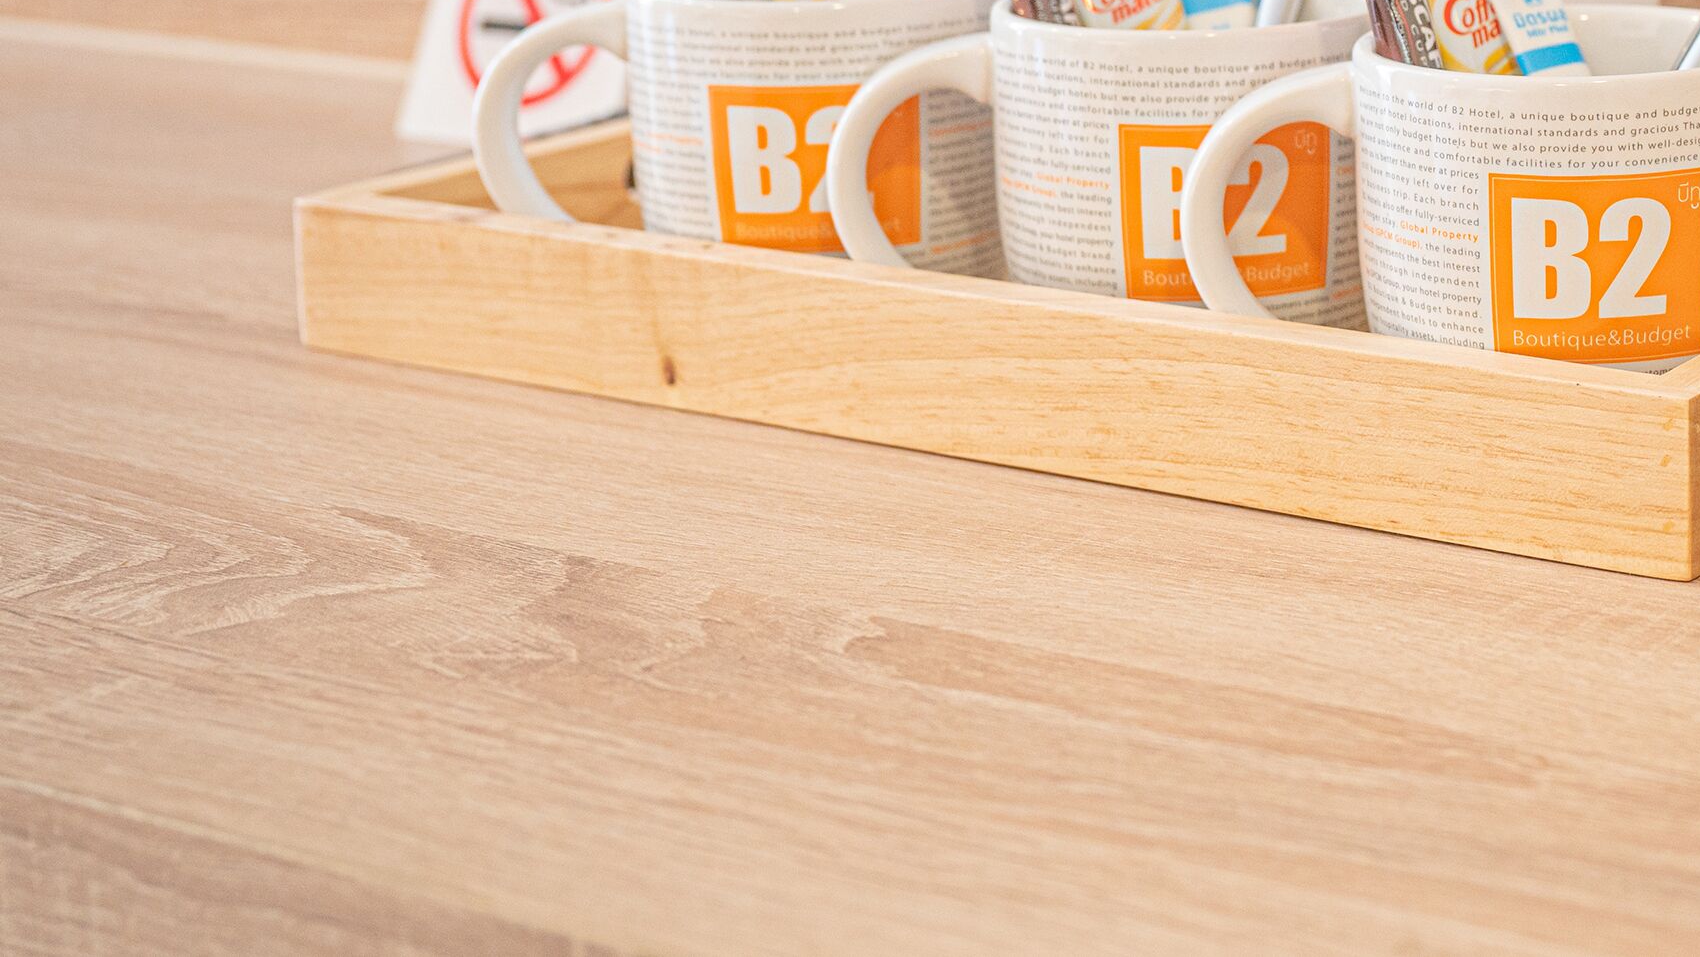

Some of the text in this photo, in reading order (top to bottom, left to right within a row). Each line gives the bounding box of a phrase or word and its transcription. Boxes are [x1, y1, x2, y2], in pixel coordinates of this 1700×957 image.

[1472, 18, 1502, 48] ma
[1148, 66, 1188, 74] unique
[1194, 64, 1249, 74] boutique
[1254, 62, 1275, 70] and
[1090, 78, 1160, 88] international
[1164, 80, 1220, 88] standards
[1392, 94, 1404, 105] the
[1408, 99, 1434, 111] world
[1438, 102, 1448, 112] of
[1452, 105, 1464, 116] B2
[1470, 108, 1504, 120] Hotel,
[1521, 112, 1564, 123] unique
[1570, 111, 1630, 122] boutique
[1635, 109, 1657, 120] and
[1388, 109, 1406, 120] hotel
[1409, 113, 1454, 130] locations,
[1459, 122, 1534, 136] international
[1538, 128, 1598, 138] standards
[1603, 126, 1625, 136] and
[1630, 124, 1680, 140] gracious
[1402, 127, 1432, 143] budget
[1435, 133, 1466, 147] hotels
[1470, 138, 1488, 149] but
[1512, 142, 1535, 152] also
[1540, 142, 1586, 154] provide
[1592, 145, 1612, 154] you
[1618, 142, 1643, 151] with
[1414, 146, 1430, 156] and
[1434, 150, 1501, 166] comfortable
[1506, 157, 1562, 168] facilities
[1568, 158, 1586, 168] for
[1592, 160, 1620, 169] your
[1624, 154, 1699, 166] convenience
[1400, 159, 1416, 170] than
[1419, 165, 1436, 174] ever
[1451, 170, 1480, 179] prices
[1386, 172, 1478, 194] money left over for
[1393, 189, 1410, 200] trip.
[1414, 194, 1436, 204] Each
[1440, 198, 1480, 211] branch
[1415, 210, 1480, 226] fully-serviced
[1400, 220, 1478, 242] Global Property
[1426, 242, 1440, 252] the
[1443, 244, 1480, 260] leading
[1510, 197, 1672, 319] B2
[1407, 254, 1419, 264] the
[1422, 257, 1440, 268] best
[1443, 262, 1480, 273] interest
[1412, 269, 1480, 288] independent
[1402, 284, 1482, 305] your hotel property
[1410, 299, 1442, 314] Budget
[1446, 306, 1482, 319] brand.
[1402, 311, 1484, 334] hotels to enhance
[1411, 328, 1485, 350] assets, including
[1513, 325, 1690, 350] Boutique&Budget
